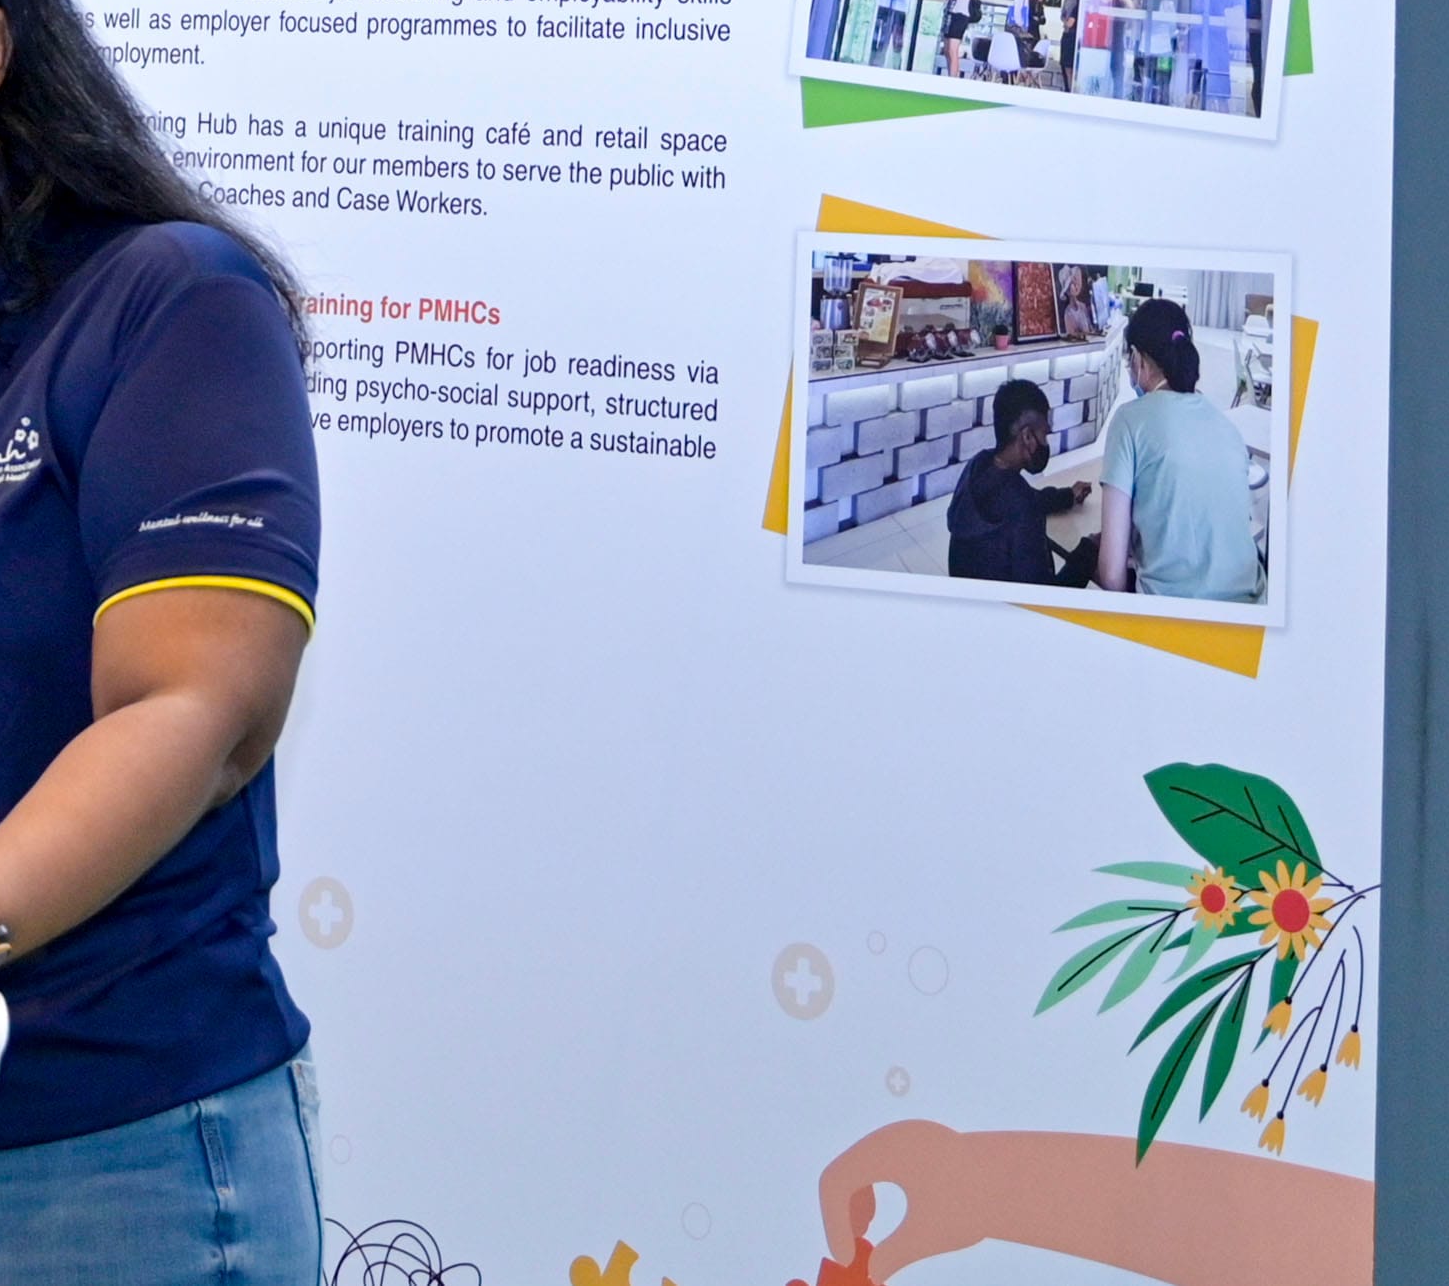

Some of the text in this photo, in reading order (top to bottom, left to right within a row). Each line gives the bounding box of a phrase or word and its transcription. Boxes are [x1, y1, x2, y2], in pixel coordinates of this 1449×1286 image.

[197, 179, 488, 216] Coaches and Case Workers.
[380, 295, 501, 326] for PMHCs
[139, 514, 180, 532] Mental
[182, 511, 228, 526] wellness
